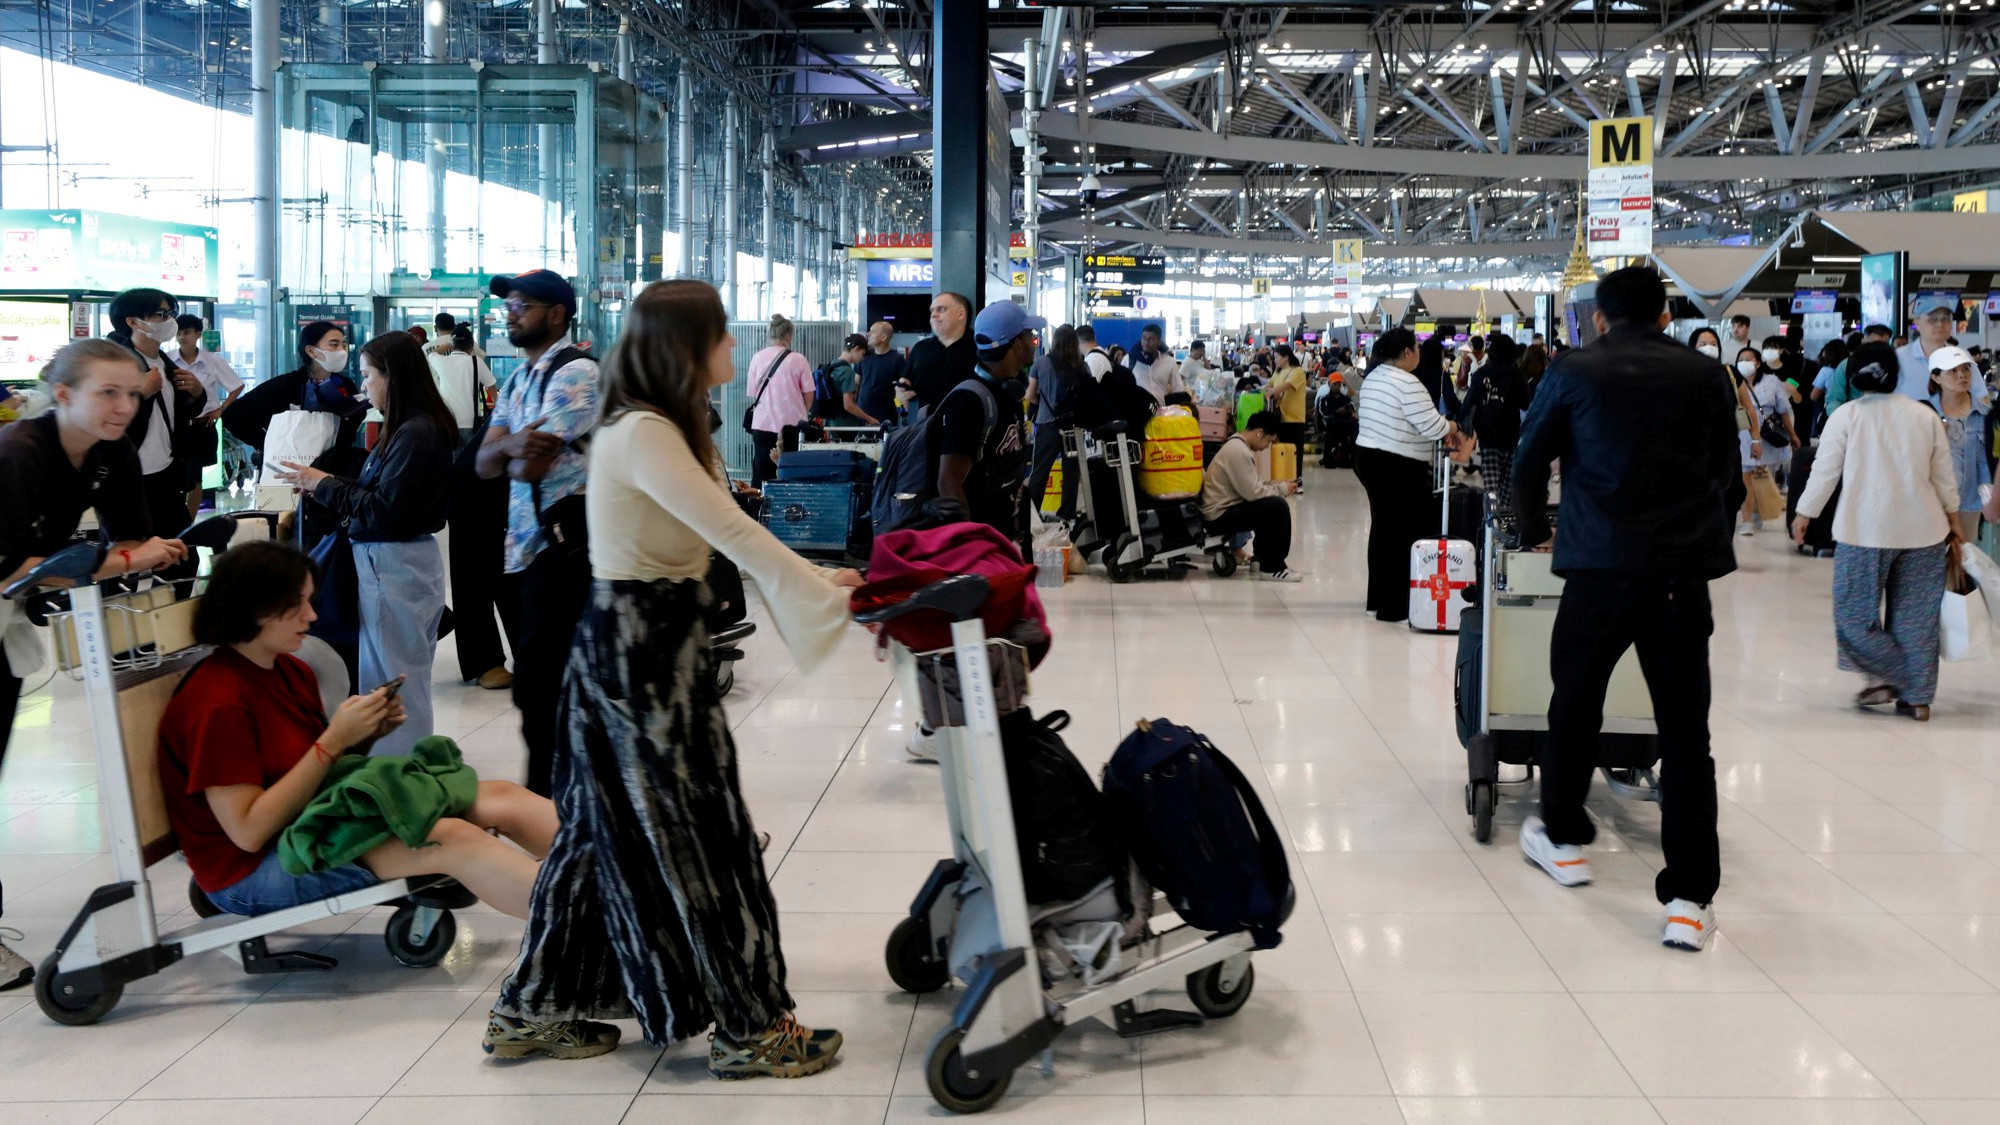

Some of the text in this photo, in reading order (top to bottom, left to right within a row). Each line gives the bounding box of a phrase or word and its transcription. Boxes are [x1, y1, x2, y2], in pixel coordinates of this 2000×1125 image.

[1602, 123, 1640, 163] M
[62, 216, 76, 225] AIS
[855, 232, 932, 247] LUGGAGE
[1339, 241, 1356, 262] K
[889, 264, 933, 282] MRS
[1824, 276, 1842, 284] M01
[1256, 280, 1267, 293] H
